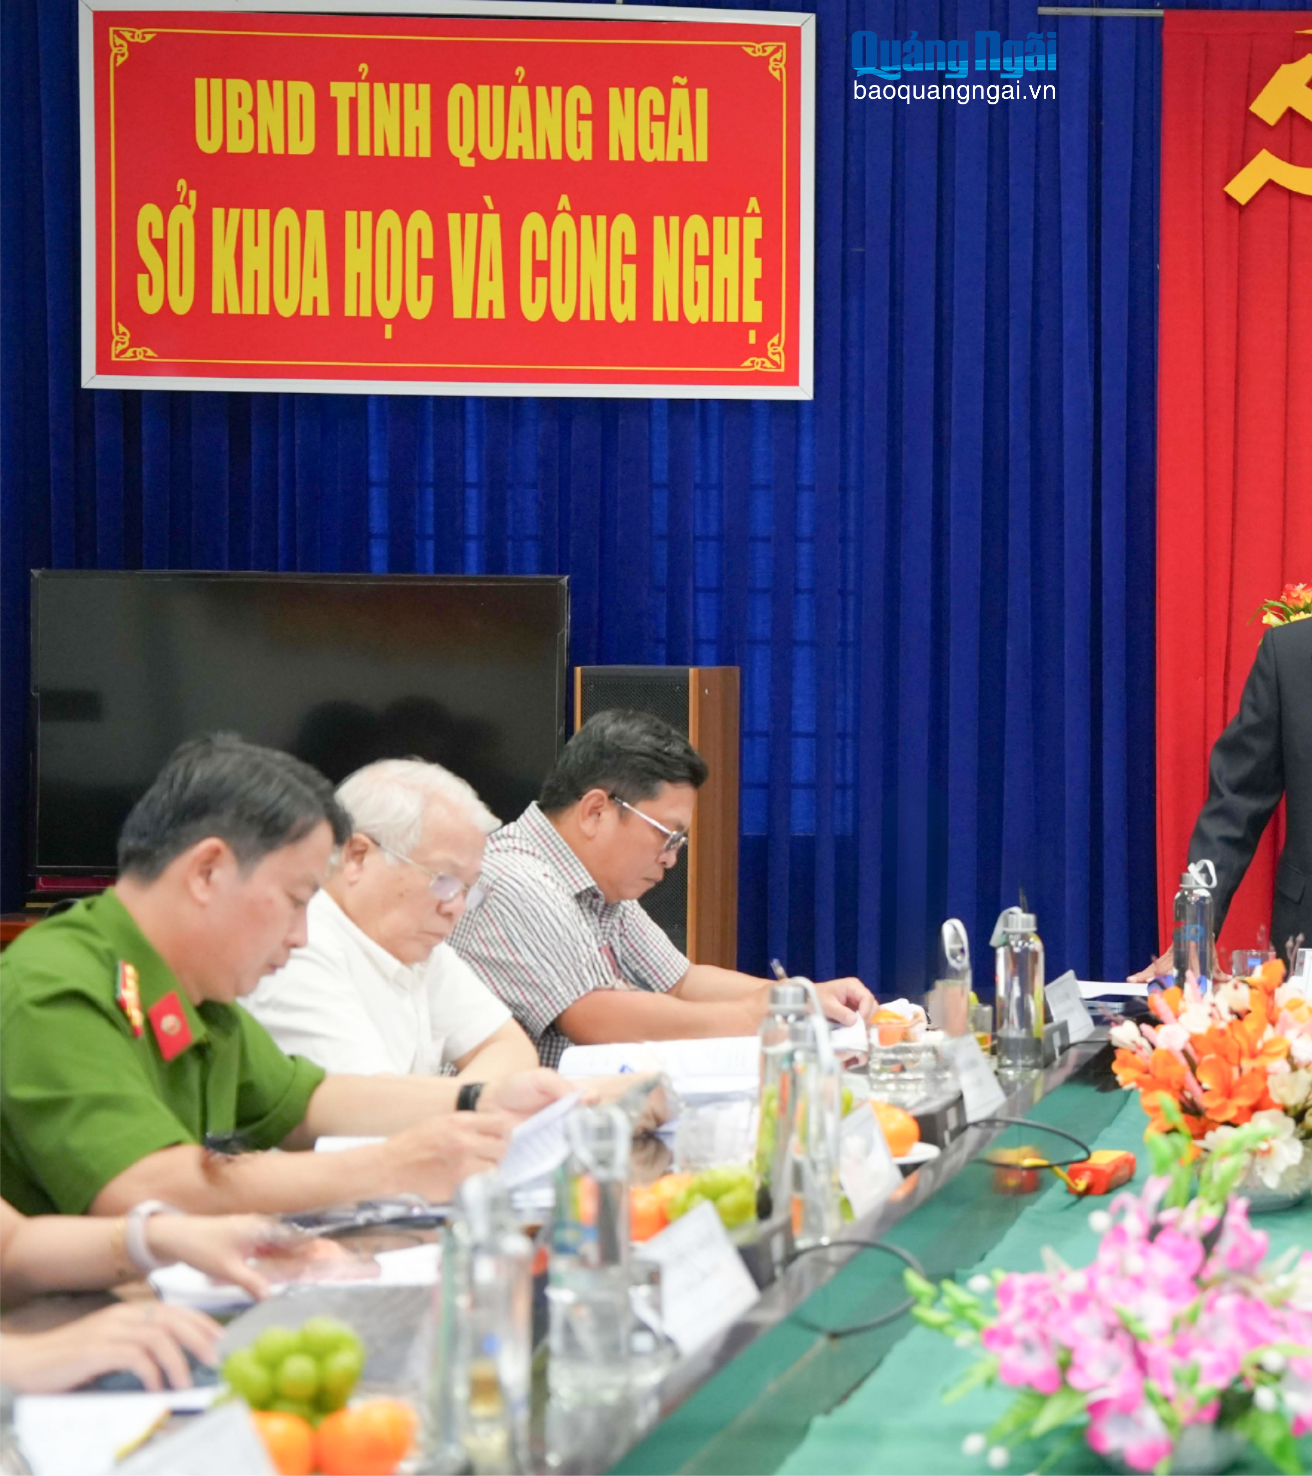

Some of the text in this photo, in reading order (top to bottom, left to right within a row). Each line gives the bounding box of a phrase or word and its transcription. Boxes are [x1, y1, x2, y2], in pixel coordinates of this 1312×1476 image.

[195, 63, 708, 167] UBND TỈNH QUẢNG NGÃI
[136, 179, 763, 344] SỞ KHOA HỌC VÀ CÔNG NGHỆ
